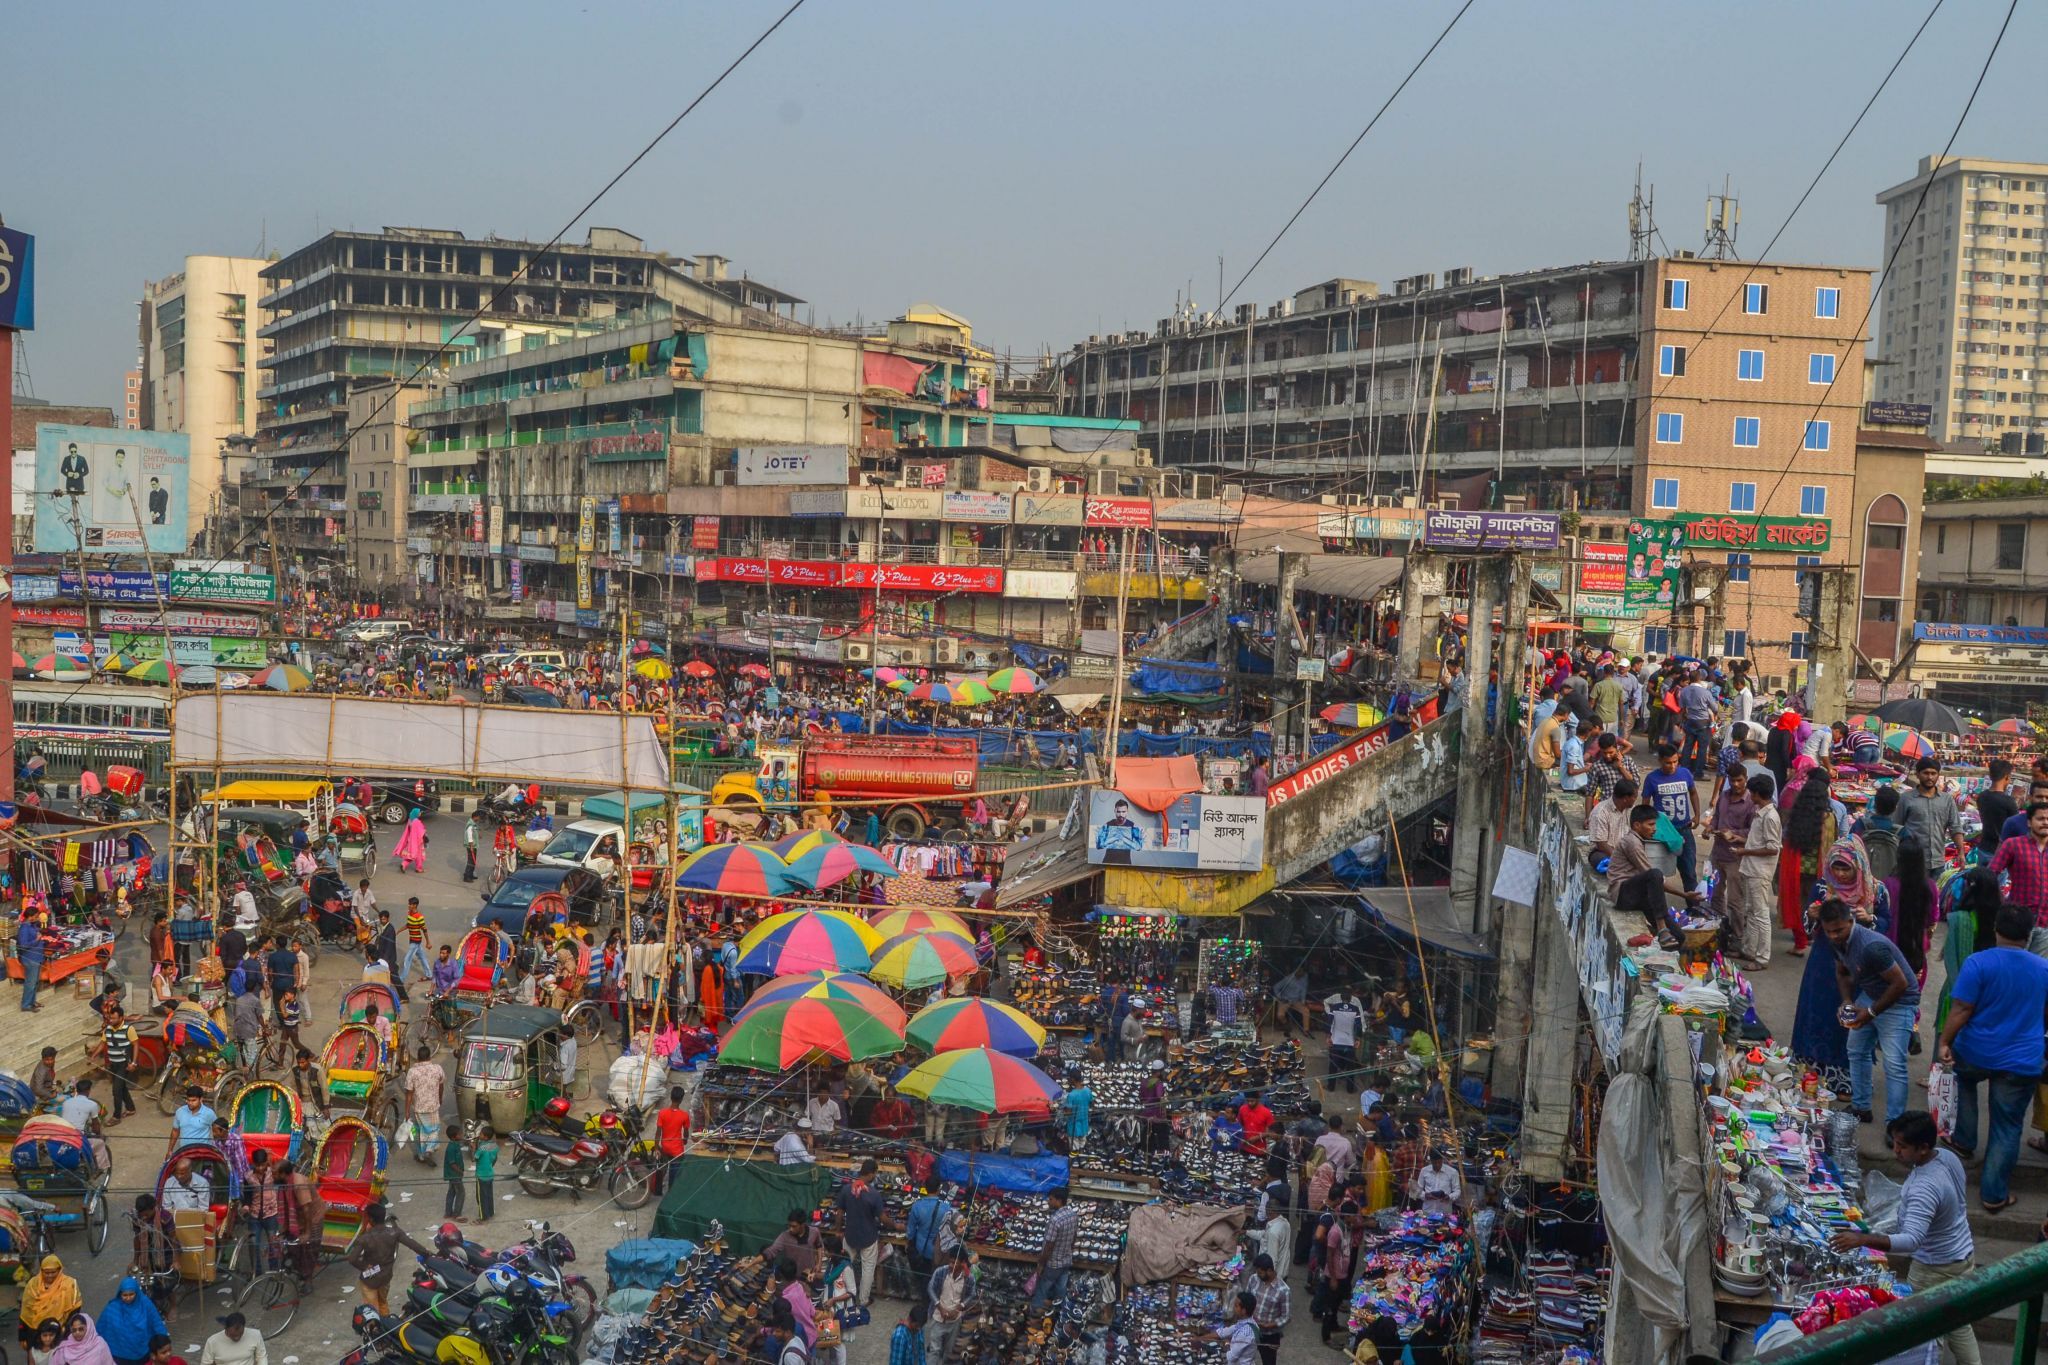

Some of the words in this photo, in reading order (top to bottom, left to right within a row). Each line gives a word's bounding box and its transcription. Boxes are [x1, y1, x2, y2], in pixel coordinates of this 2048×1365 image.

[1766, 521, 1829, 546] মার্কেট
[56, 646, 74, 655] FANCY
[1292, 754, 1350, 796] LADIES
[1660, 782, 1688, 794] BRONX
[1202, 808, 1223, 823] নিউ
[1226, 813, 1259, 825] আনন্দ
[1661, 794, 1687, 822] 99
[1941, 1078, 1951, 1113] SALE
